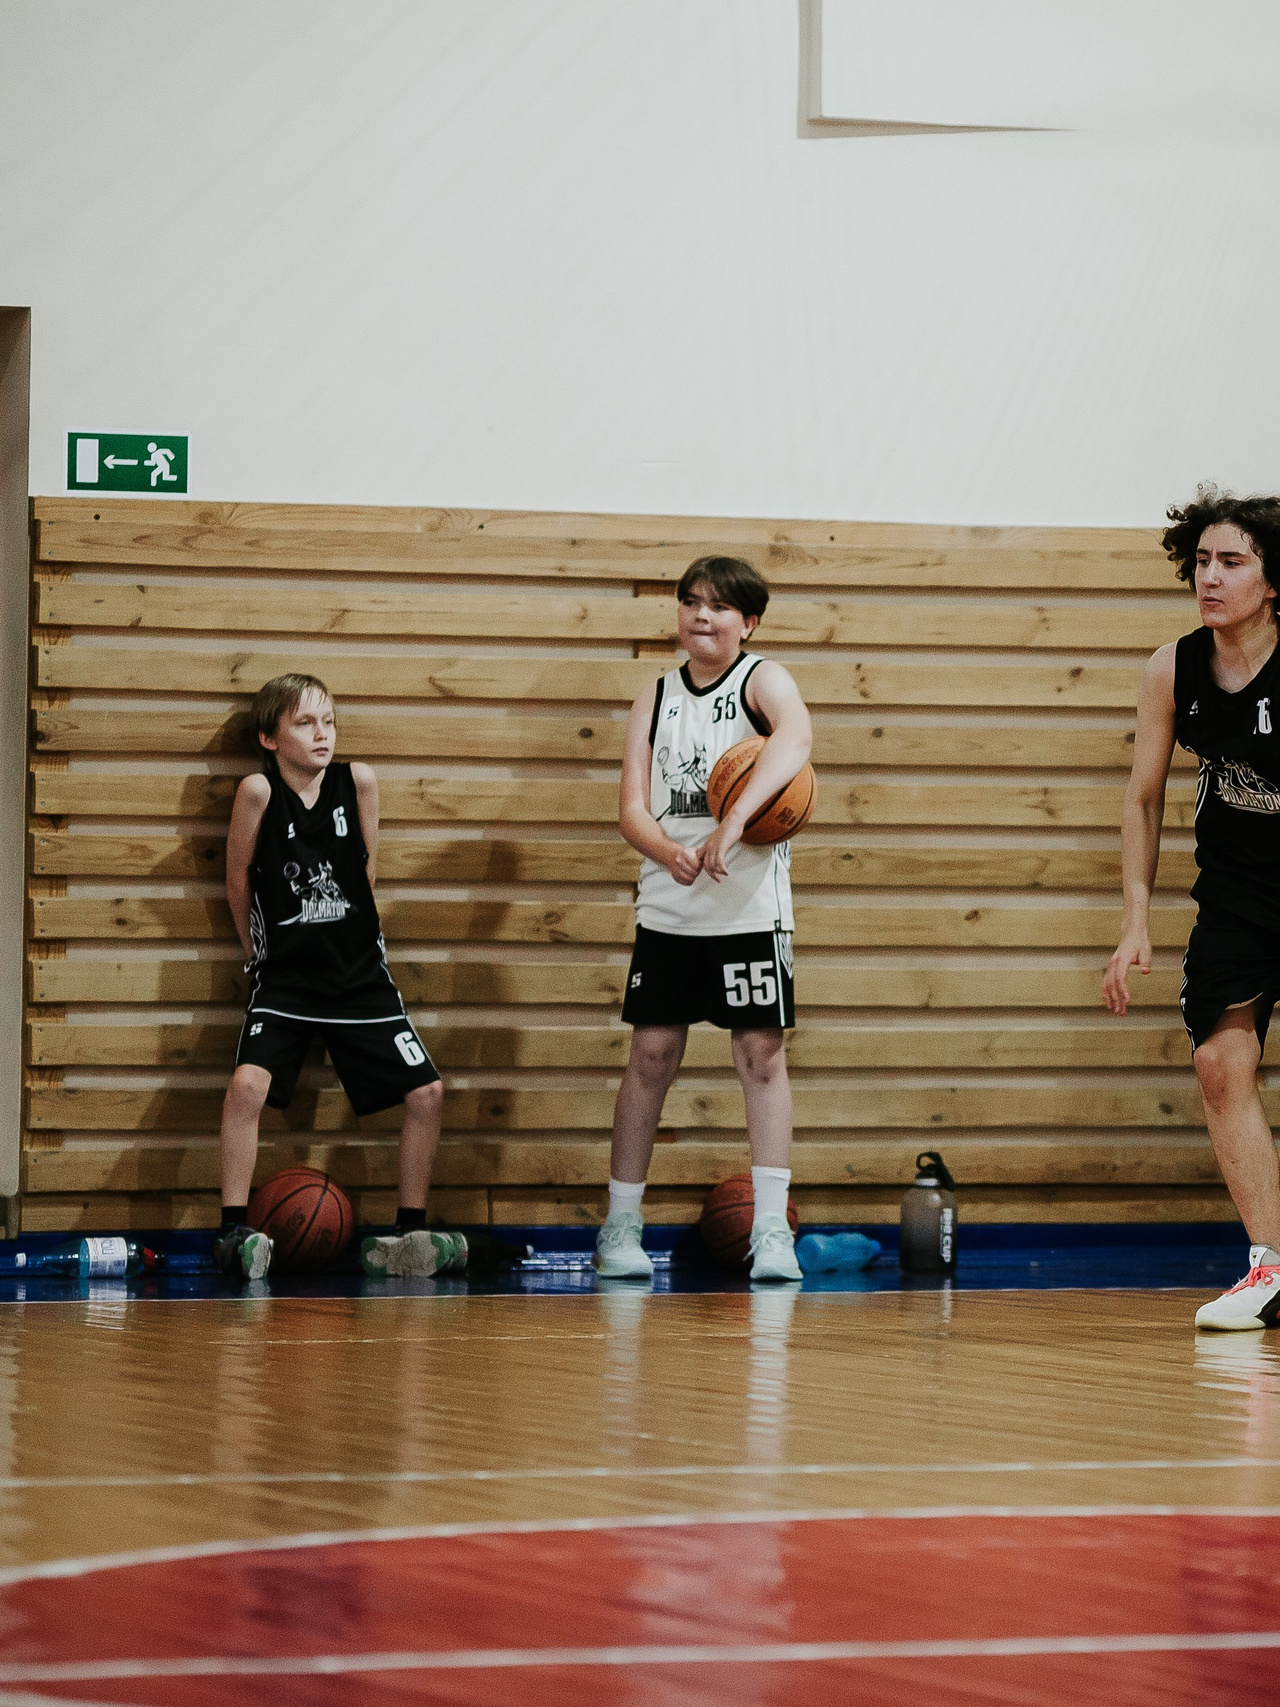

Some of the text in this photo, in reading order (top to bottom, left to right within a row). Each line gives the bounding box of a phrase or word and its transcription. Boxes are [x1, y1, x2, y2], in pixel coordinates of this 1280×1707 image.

[332, 805, 348, 836] 6
[723, 960, 777, 1006] 55
[394, 1031, 426, 1066] 6
